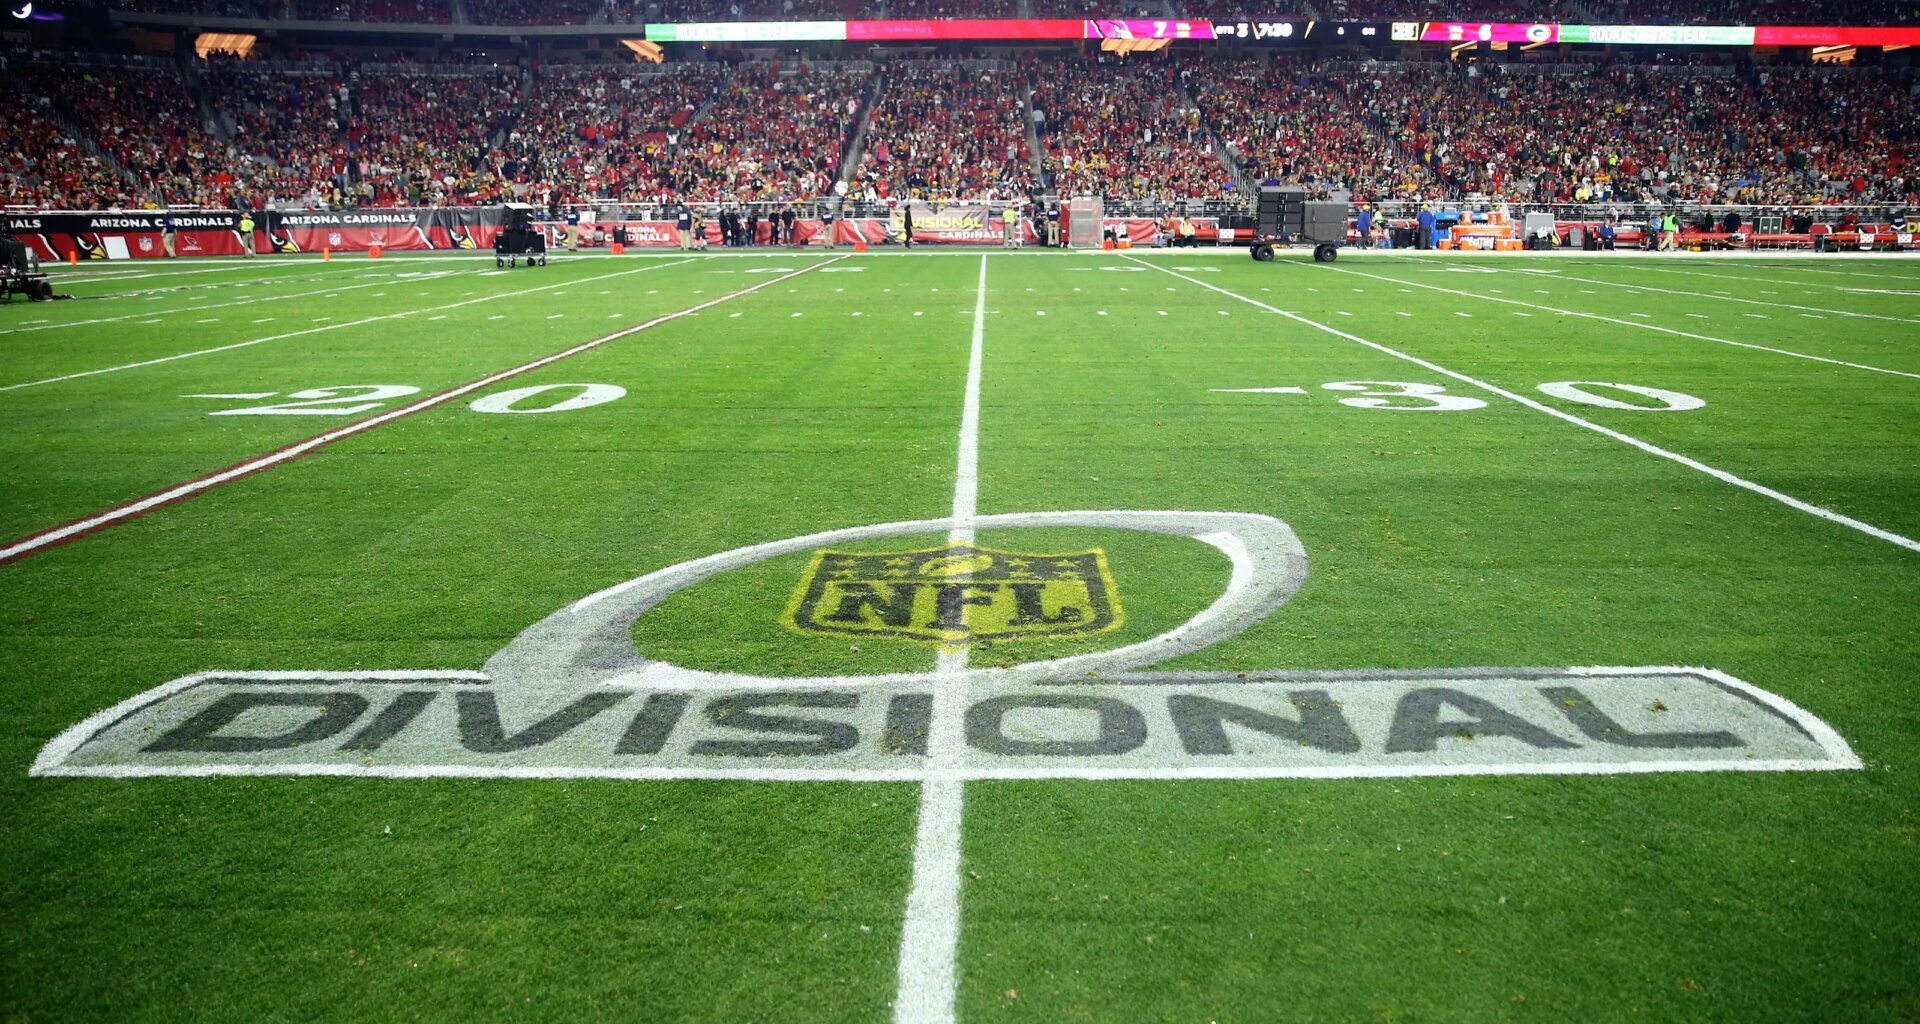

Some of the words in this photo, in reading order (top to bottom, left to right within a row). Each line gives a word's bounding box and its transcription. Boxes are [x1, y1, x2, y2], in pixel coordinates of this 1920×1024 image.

[1154, 21, 1167, 37] 7
[1478, 23, 1492, 39] 6
[91, 217, 150, 228] ARIZONA
[154, 216, 234, 228] CRDINALS
[281, 215, 340, 225] ARIZONA
[343, 213, 417, 224] CARDINALS
[895, 216, 984, 229] DVISIONAL
[938, 231, 1004, 239] CARDINALS
[824, 582, 1083, 632] NFL
[138, 687, 1747, 757] DIVISIONAL
